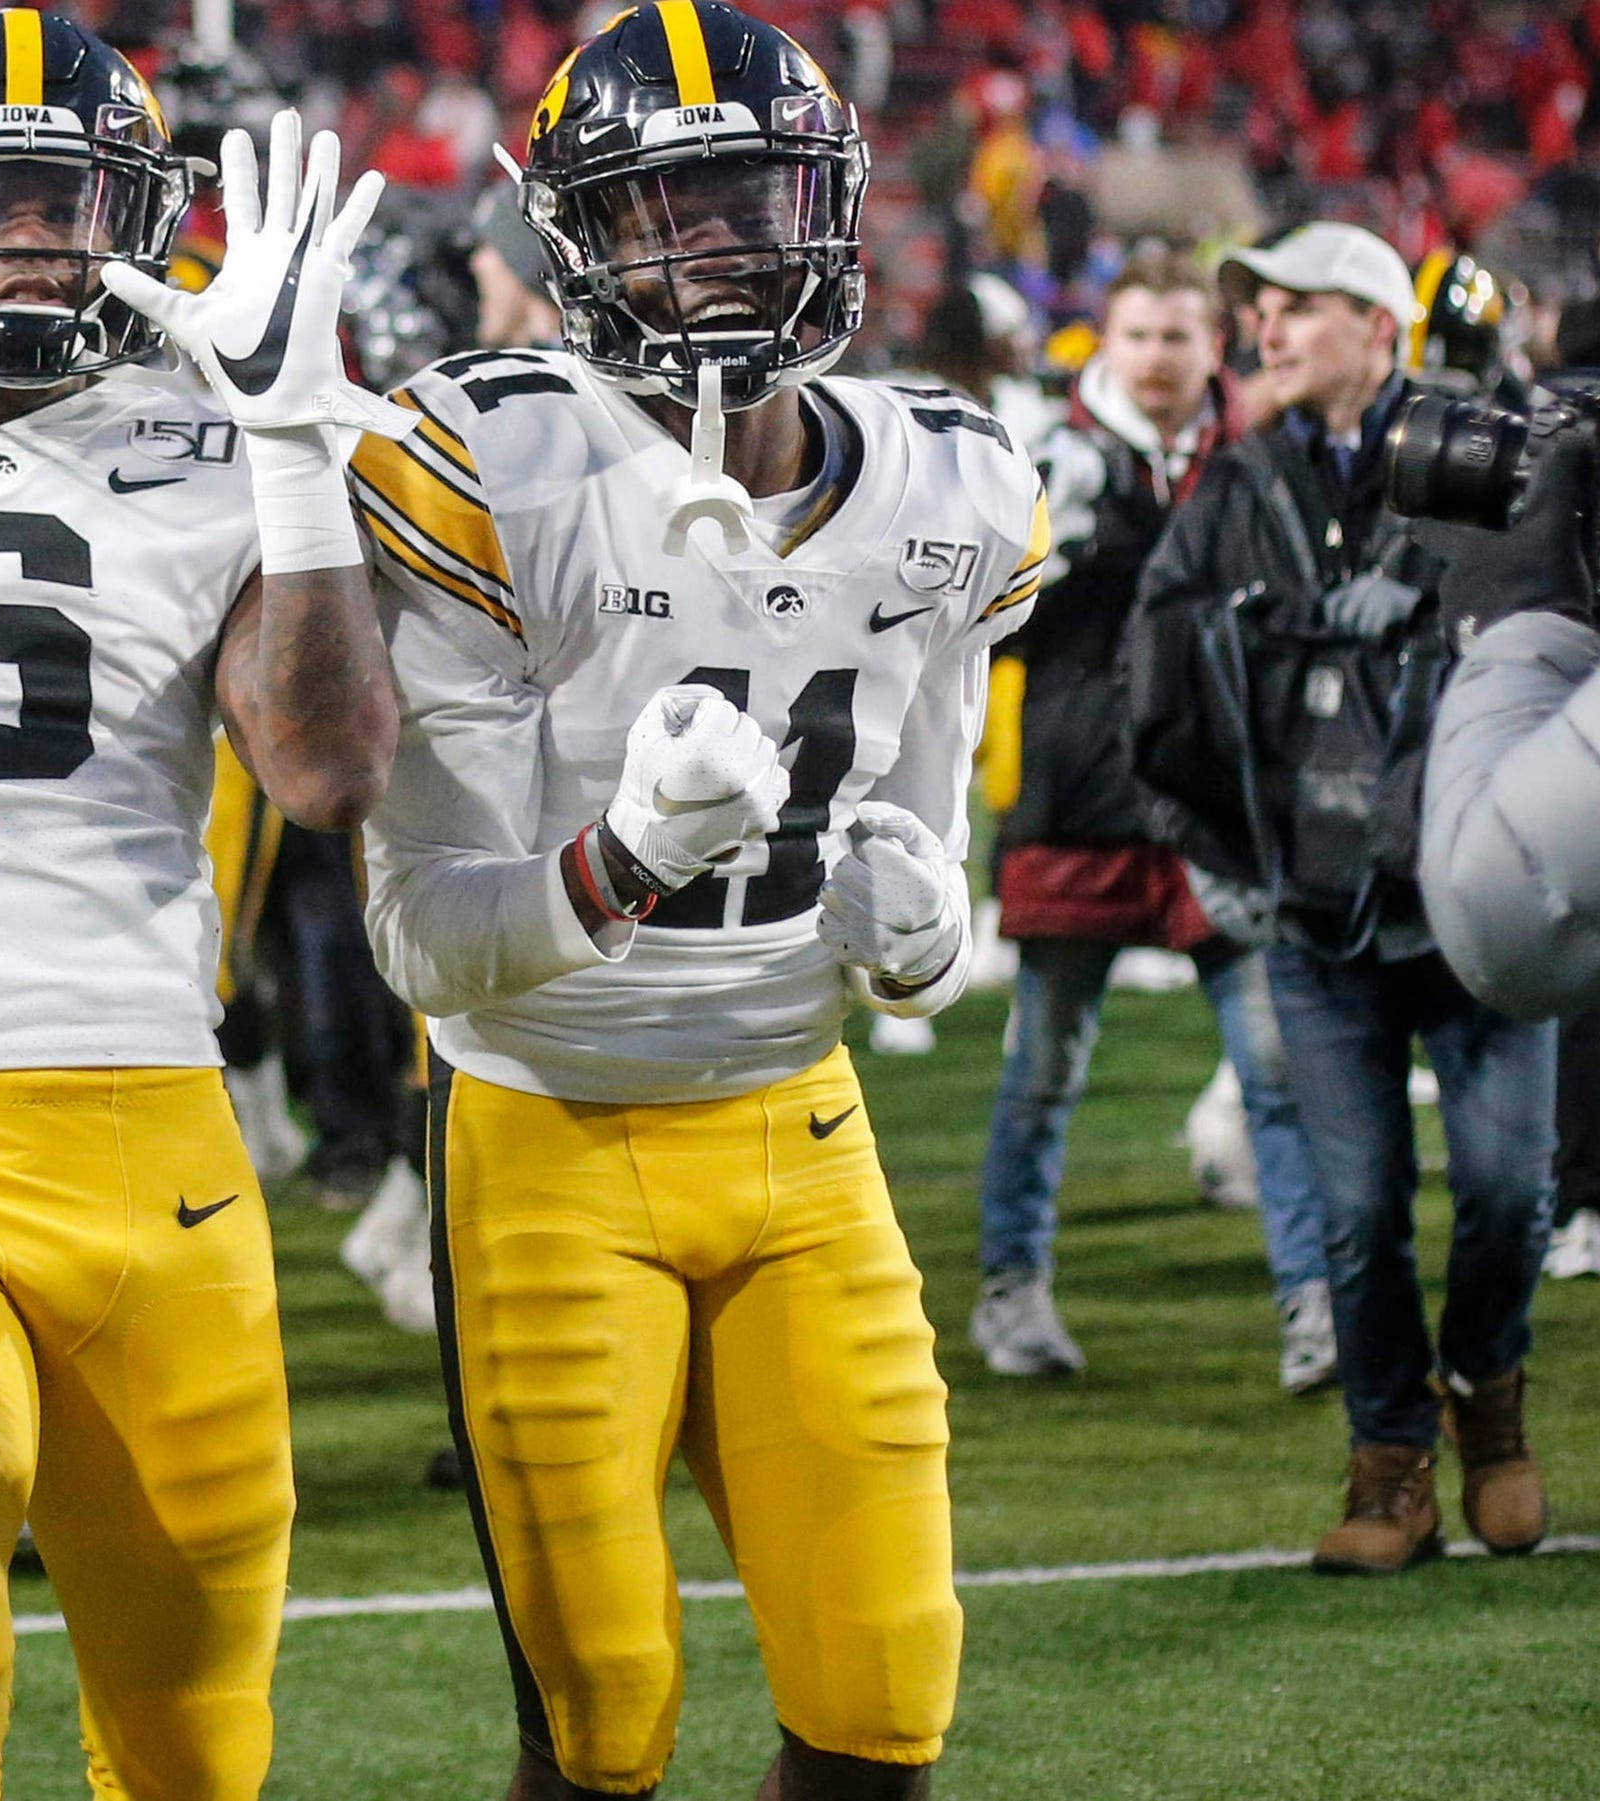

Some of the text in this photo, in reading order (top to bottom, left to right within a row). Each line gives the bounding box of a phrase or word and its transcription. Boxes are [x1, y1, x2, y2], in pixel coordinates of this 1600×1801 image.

[2, 107, 53, 124] IOWA
[674, 106, 726, 127] IOWA
[133, 418, 238, 463] 150
